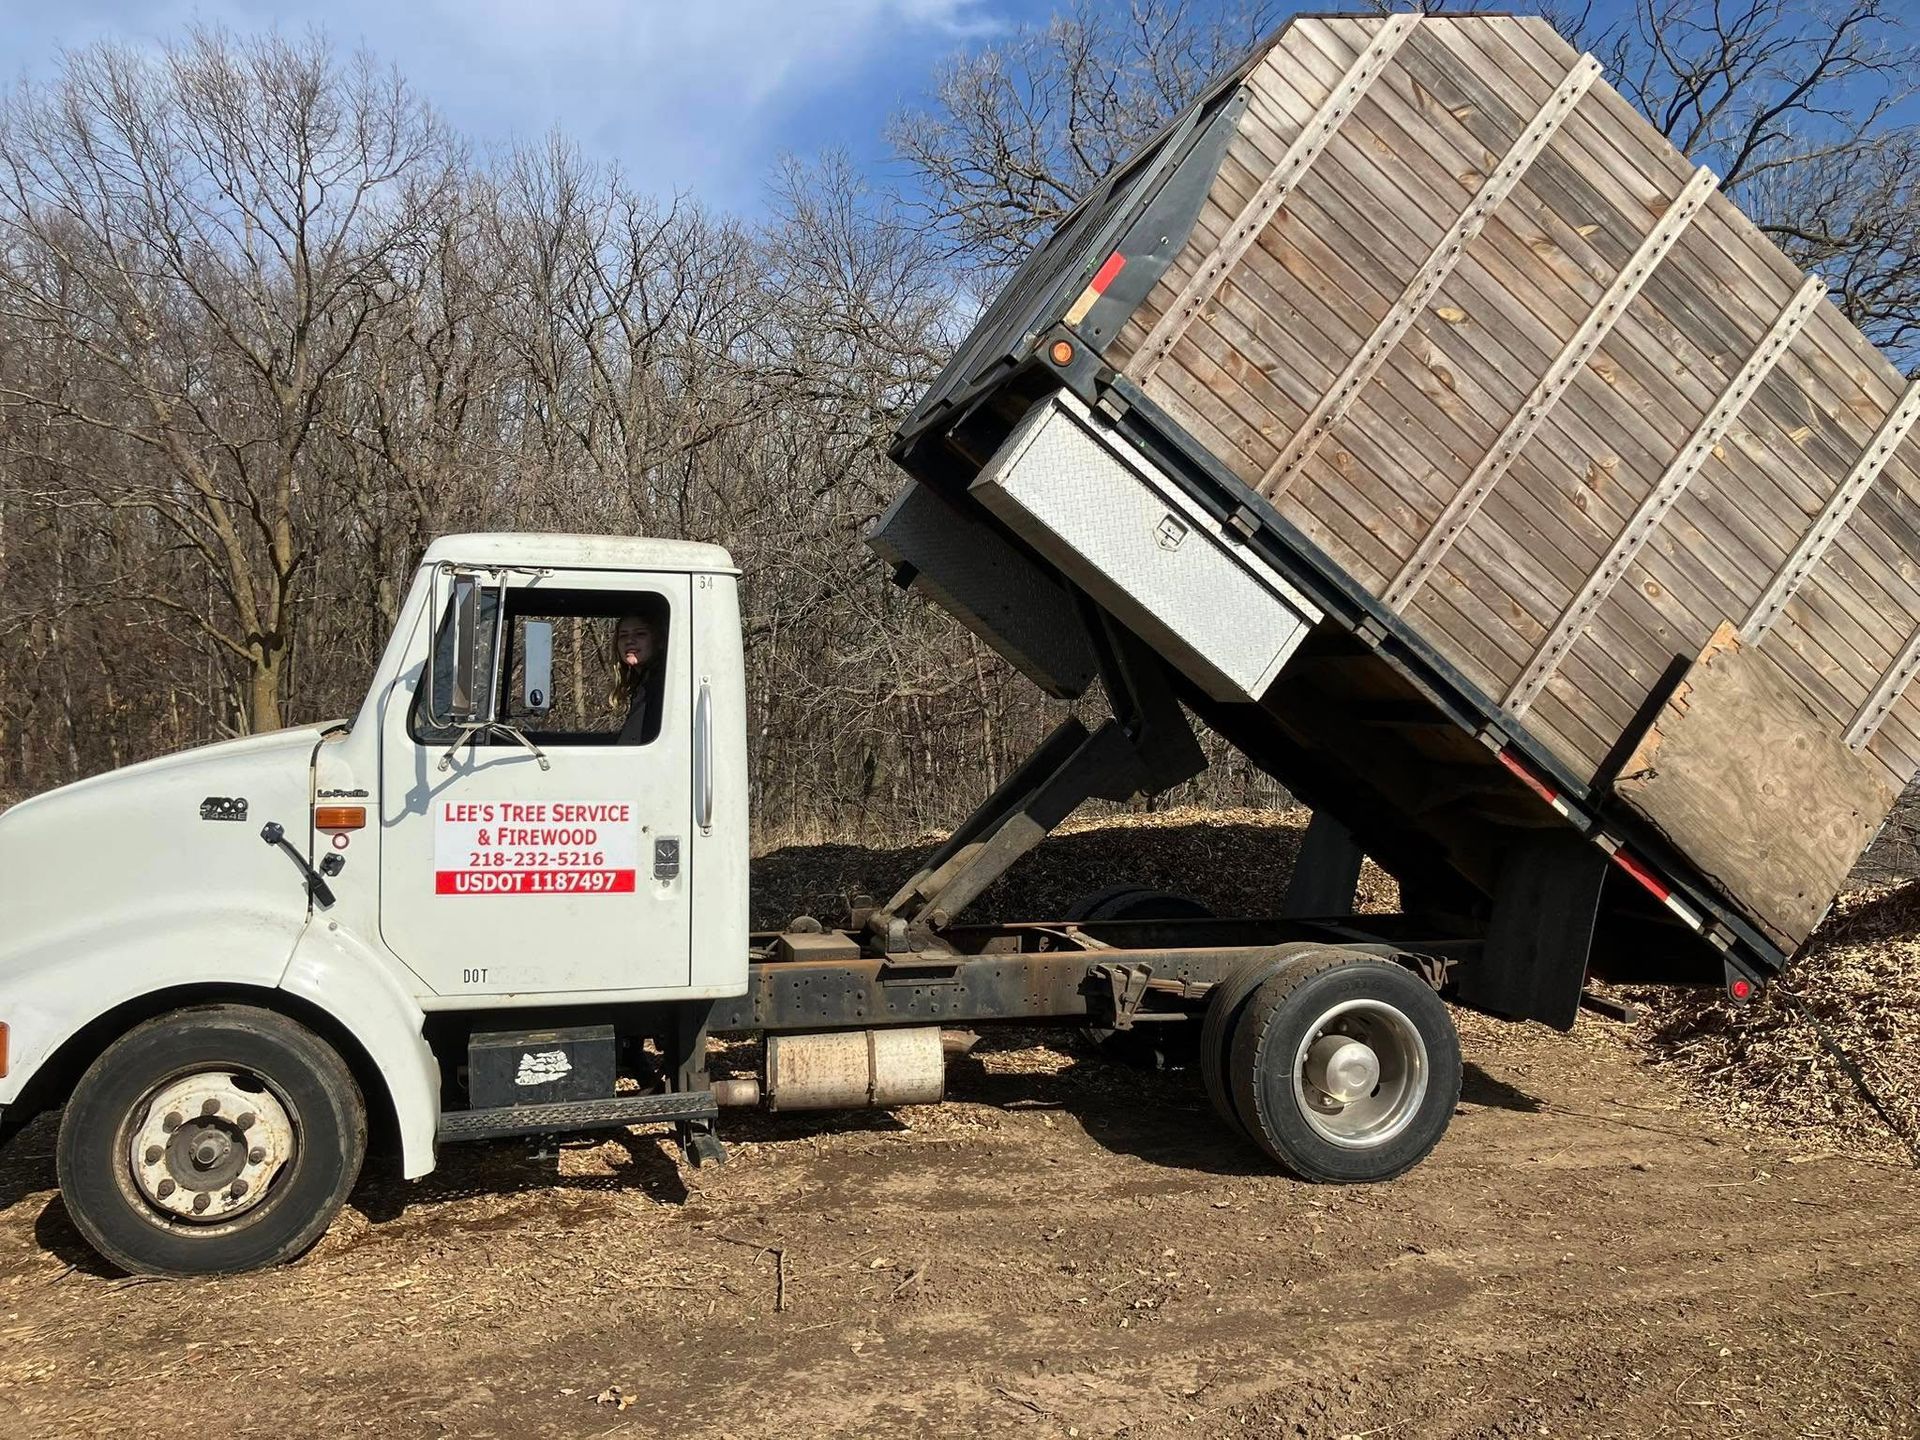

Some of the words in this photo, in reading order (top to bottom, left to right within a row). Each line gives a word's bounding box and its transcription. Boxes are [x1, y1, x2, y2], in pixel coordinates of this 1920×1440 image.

[445, 803, 494, 822] LEE'S
[500, 803, 546, 822] TREE
[552, 803, 630, 822] SERVICE
[477, 829, 491, 846] &
[498, 827, 597, 846] FIREWOOD
[469, 852, 604, 867] 218-232-5216
[455, 873, 525, 892] USDOT
[531, 872, 616, 891] 1187497
[463, 968, 488, 984] DOT
